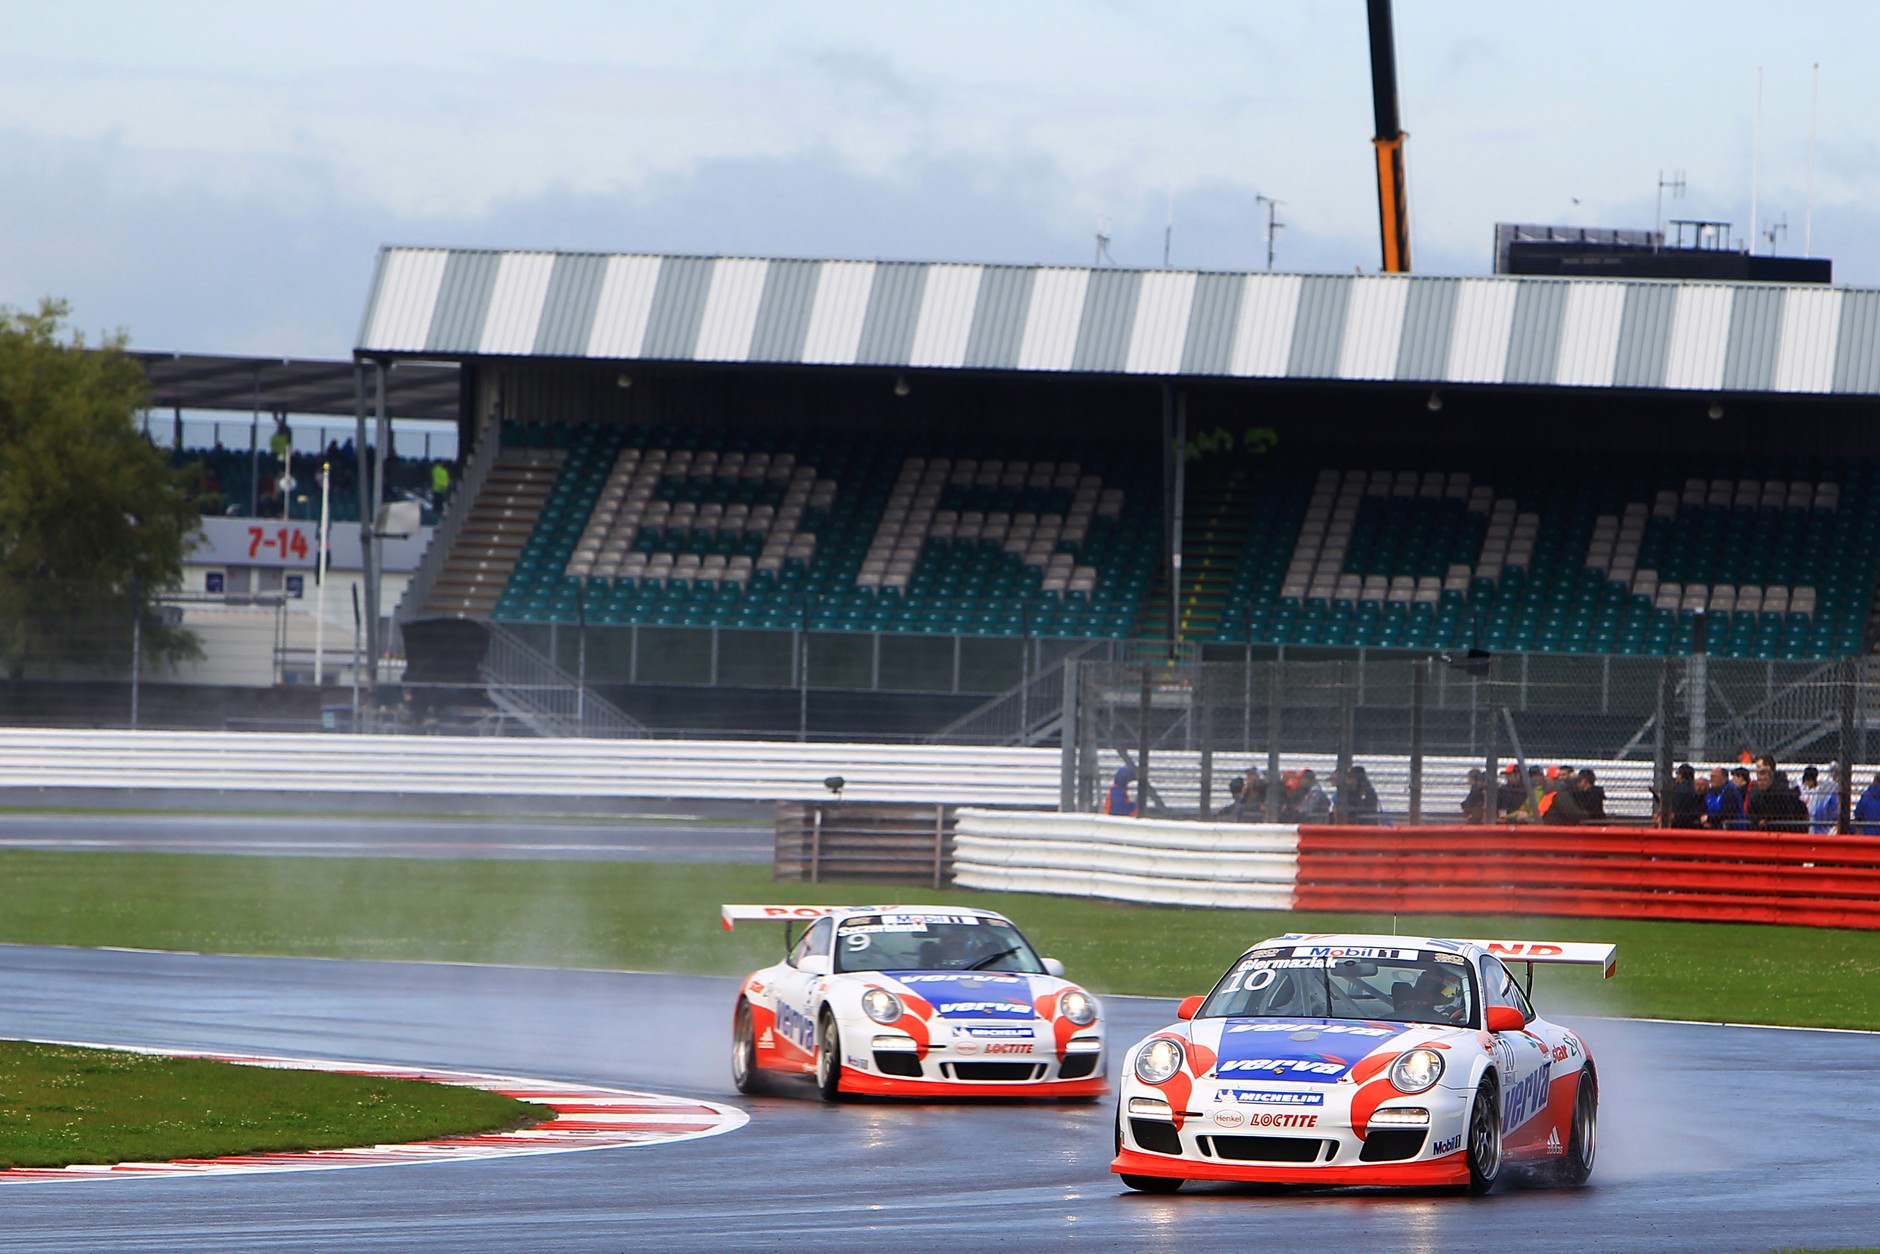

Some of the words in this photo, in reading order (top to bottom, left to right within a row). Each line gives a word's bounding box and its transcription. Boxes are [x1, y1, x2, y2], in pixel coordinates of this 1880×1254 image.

[247, 526, 309, 560] 7-14
[896, 914, 945, 926] Mobil
[846, 933, 872, 952] 9
[1309, 946, 1373, 957] Mobil
[899, 974, 1020, 984] verva
[1221, 968, 1276, 994] 10
[940, 1002, 1033, 1014] verva
[1227, 1023, 1394, 1037] verva
[983, 1043, 1035, 1054] LOCTITE
[1498, 1039, 1515, 1071] 10
[1552, 1043, 1569, 1064] star
[1218, 1058, 1346, 1075] verva
[1238, 1092, 1322, 1103] MICHELIN
[1502, 1060, 1552, 1135] verva
[1250, 1113, 1318, 1128] LOCTITE
[1433, 1136, 1454, 1155] Mobil
